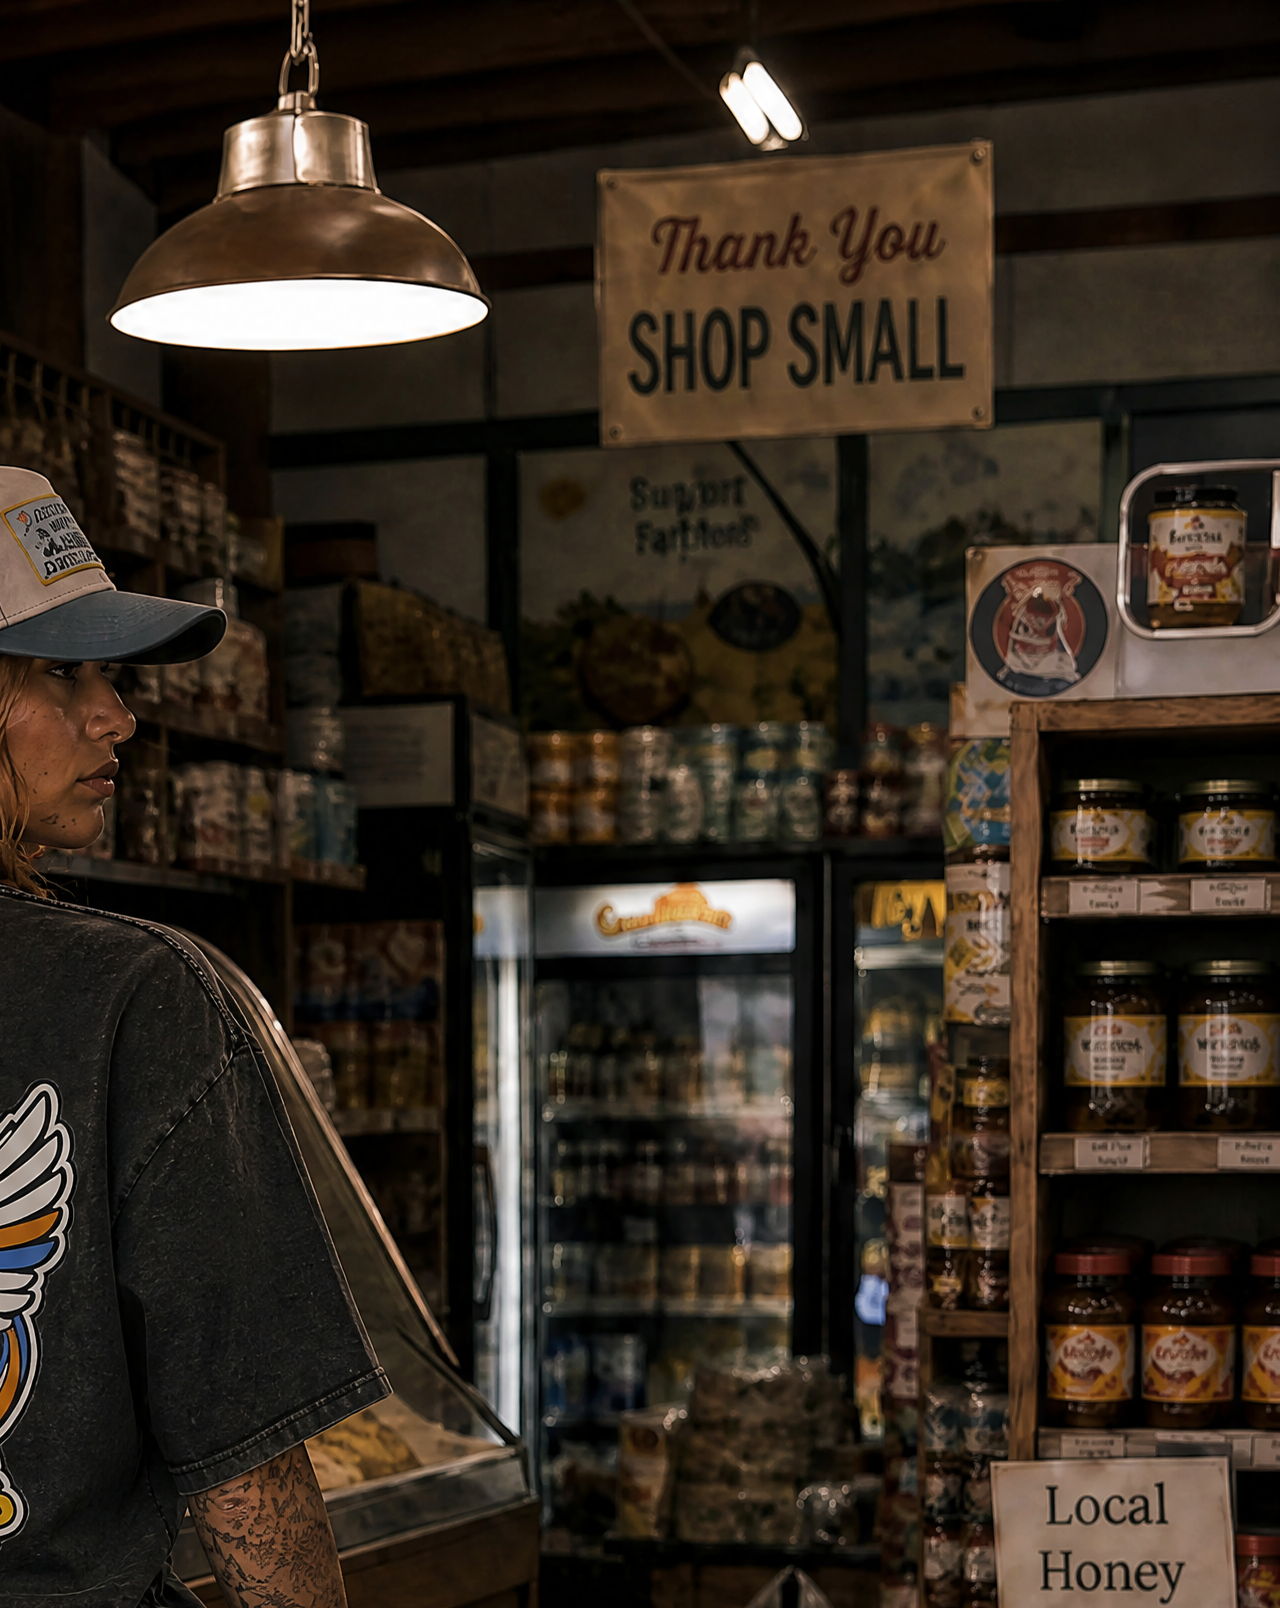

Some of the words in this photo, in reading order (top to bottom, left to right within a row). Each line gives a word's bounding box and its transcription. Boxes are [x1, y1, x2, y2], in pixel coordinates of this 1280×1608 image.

[649, 211, 817, 276] Thank
[828, 205, 946, 287] You
[627, 305, 771, 395] SHOP
[786, 295, 965, 388] SMALL
[1045, 1481, 1169, 1526] Local
[1038, 1549, 1186, 1605] Honey
